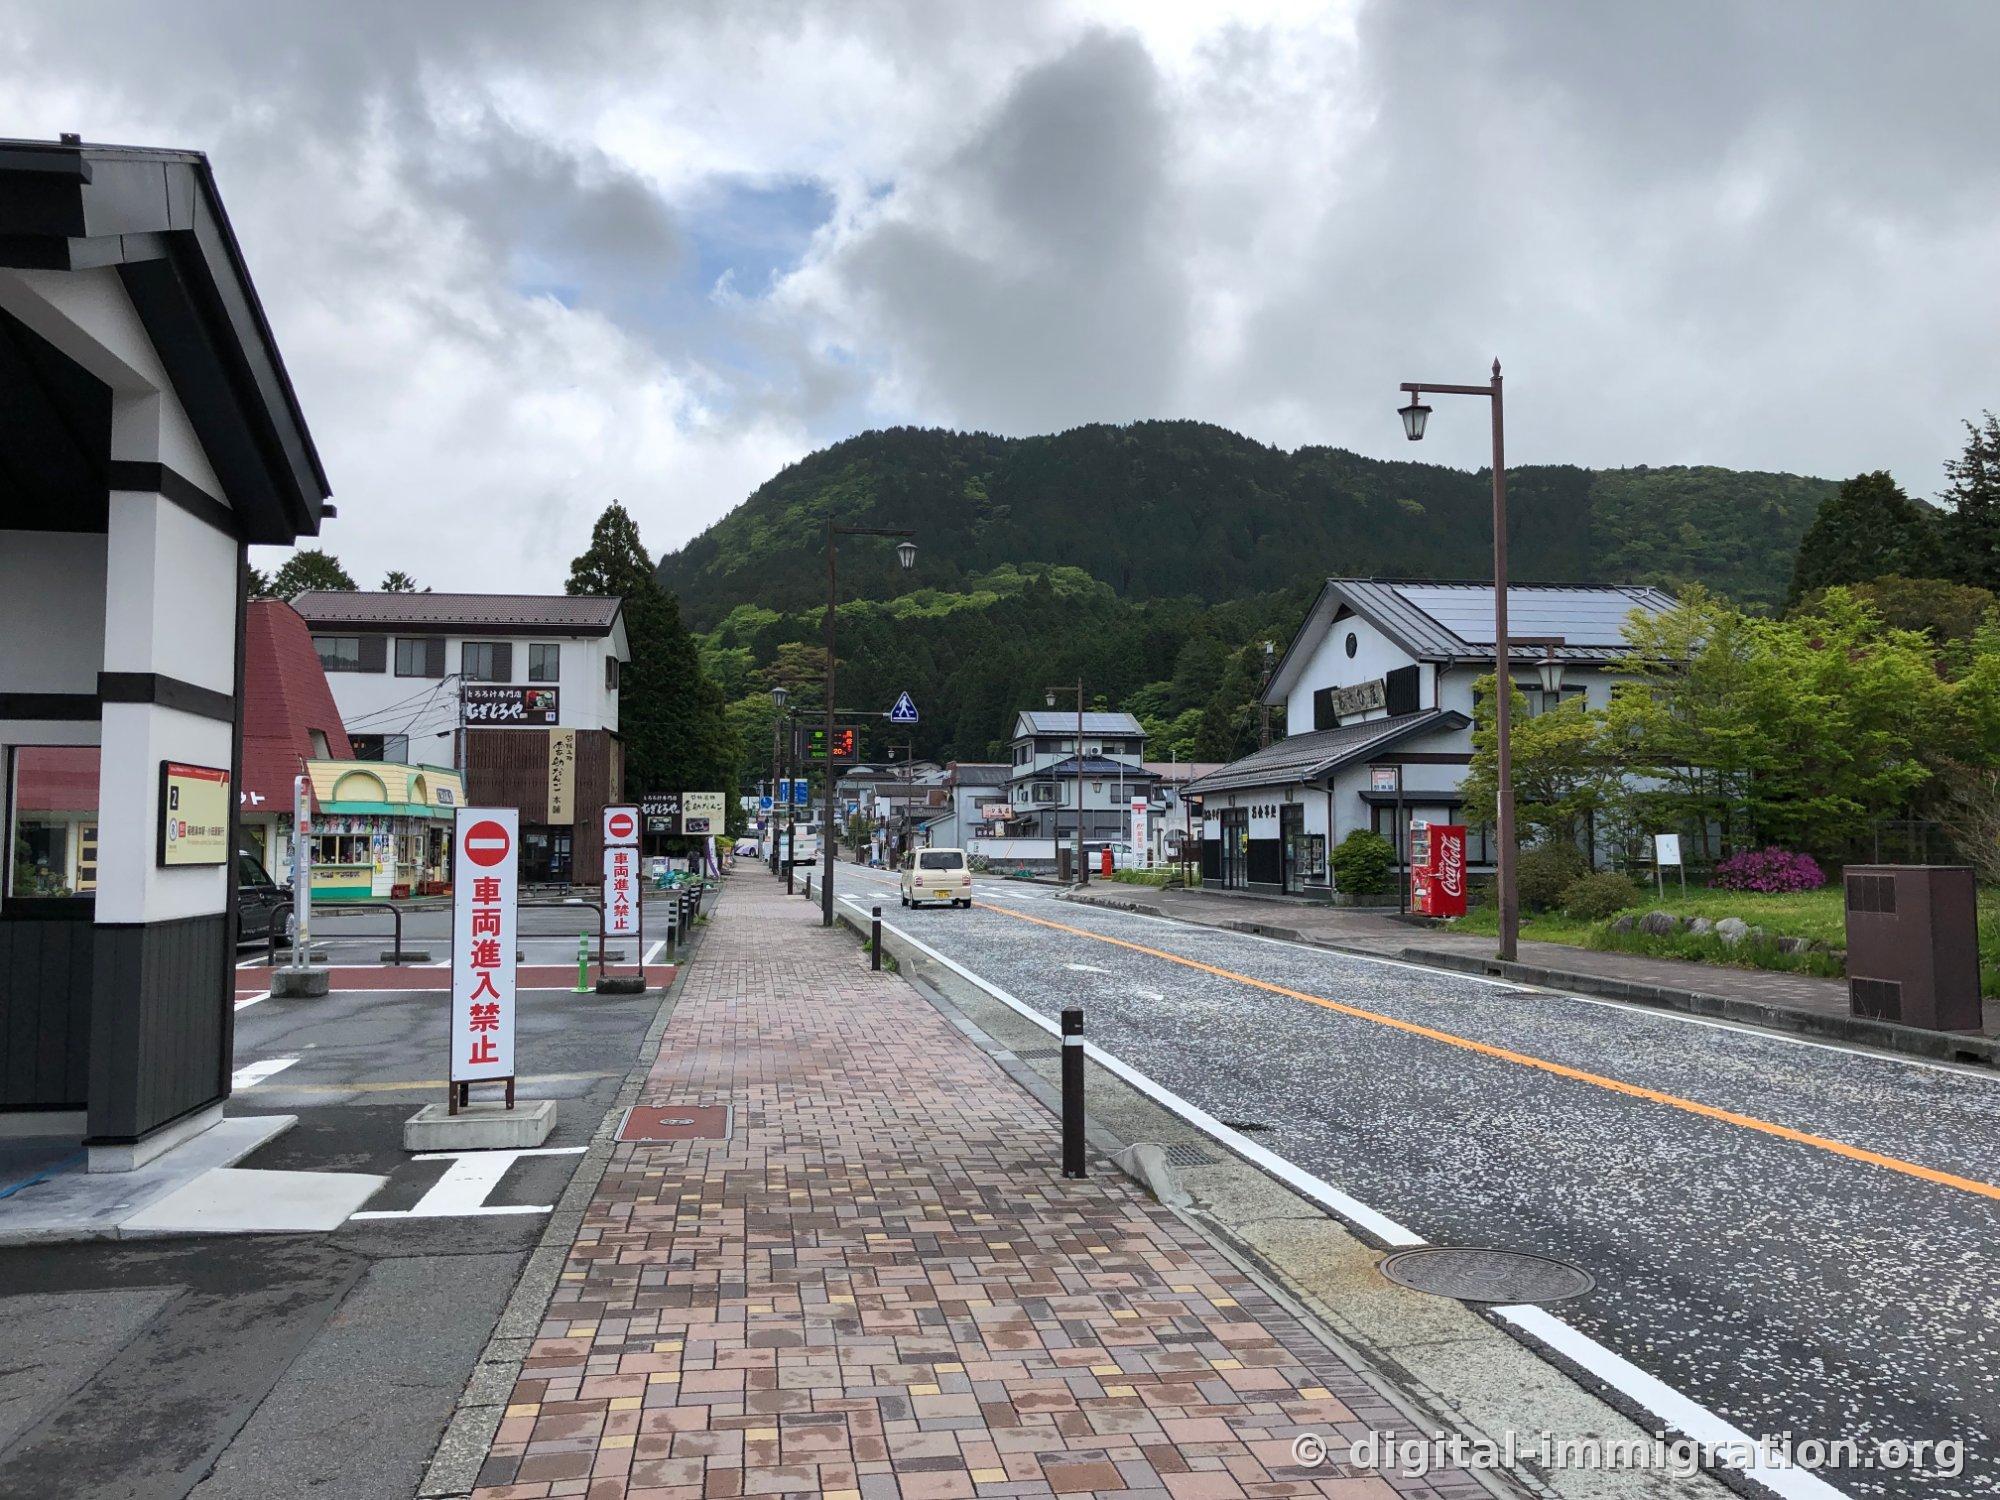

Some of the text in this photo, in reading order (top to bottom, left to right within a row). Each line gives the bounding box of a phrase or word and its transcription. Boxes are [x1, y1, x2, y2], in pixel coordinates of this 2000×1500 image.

[467, 689, 522, 698] とろろ汁専門店
[466, 701, 523, 720] むぎとろや
[171, 789, 177, 807] 2
[613, 852, 629, 930] 車両進入禁止
[468, 876, 502, 1065] 車両進入禁止
